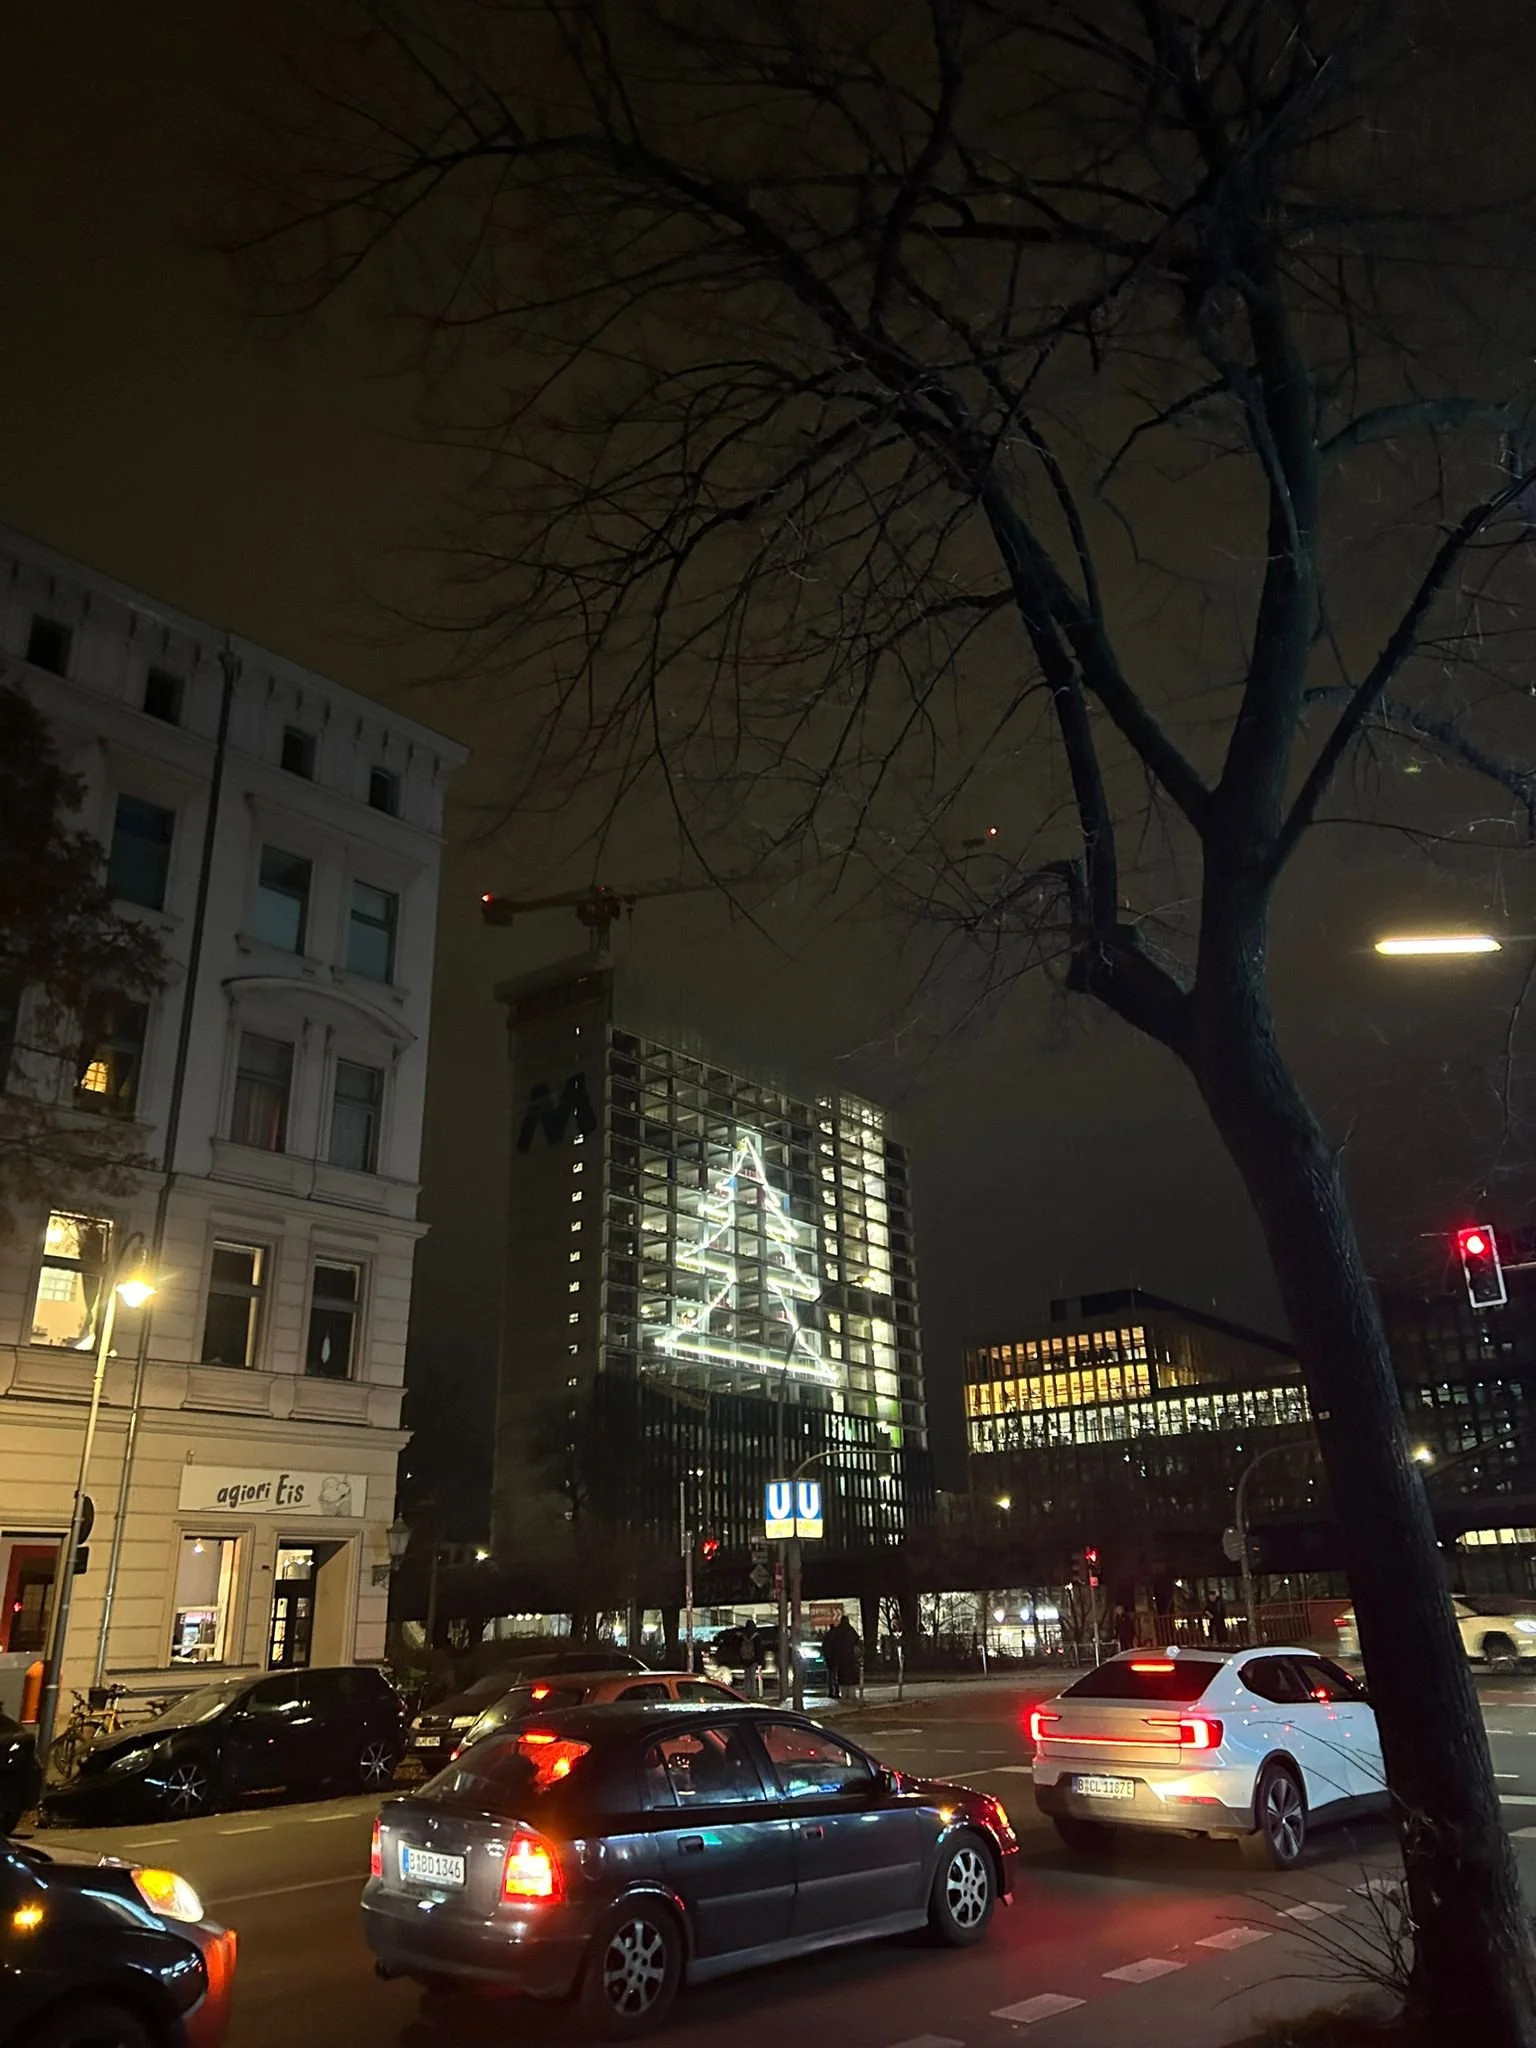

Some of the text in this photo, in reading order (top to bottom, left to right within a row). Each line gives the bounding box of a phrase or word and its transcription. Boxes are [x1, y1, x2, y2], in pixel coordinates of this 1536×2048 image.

[217, 1474, 304, 1508] agiori Eis
[769, 1483, 790, 1519] U
[799, 1483, 819, 1519] U
